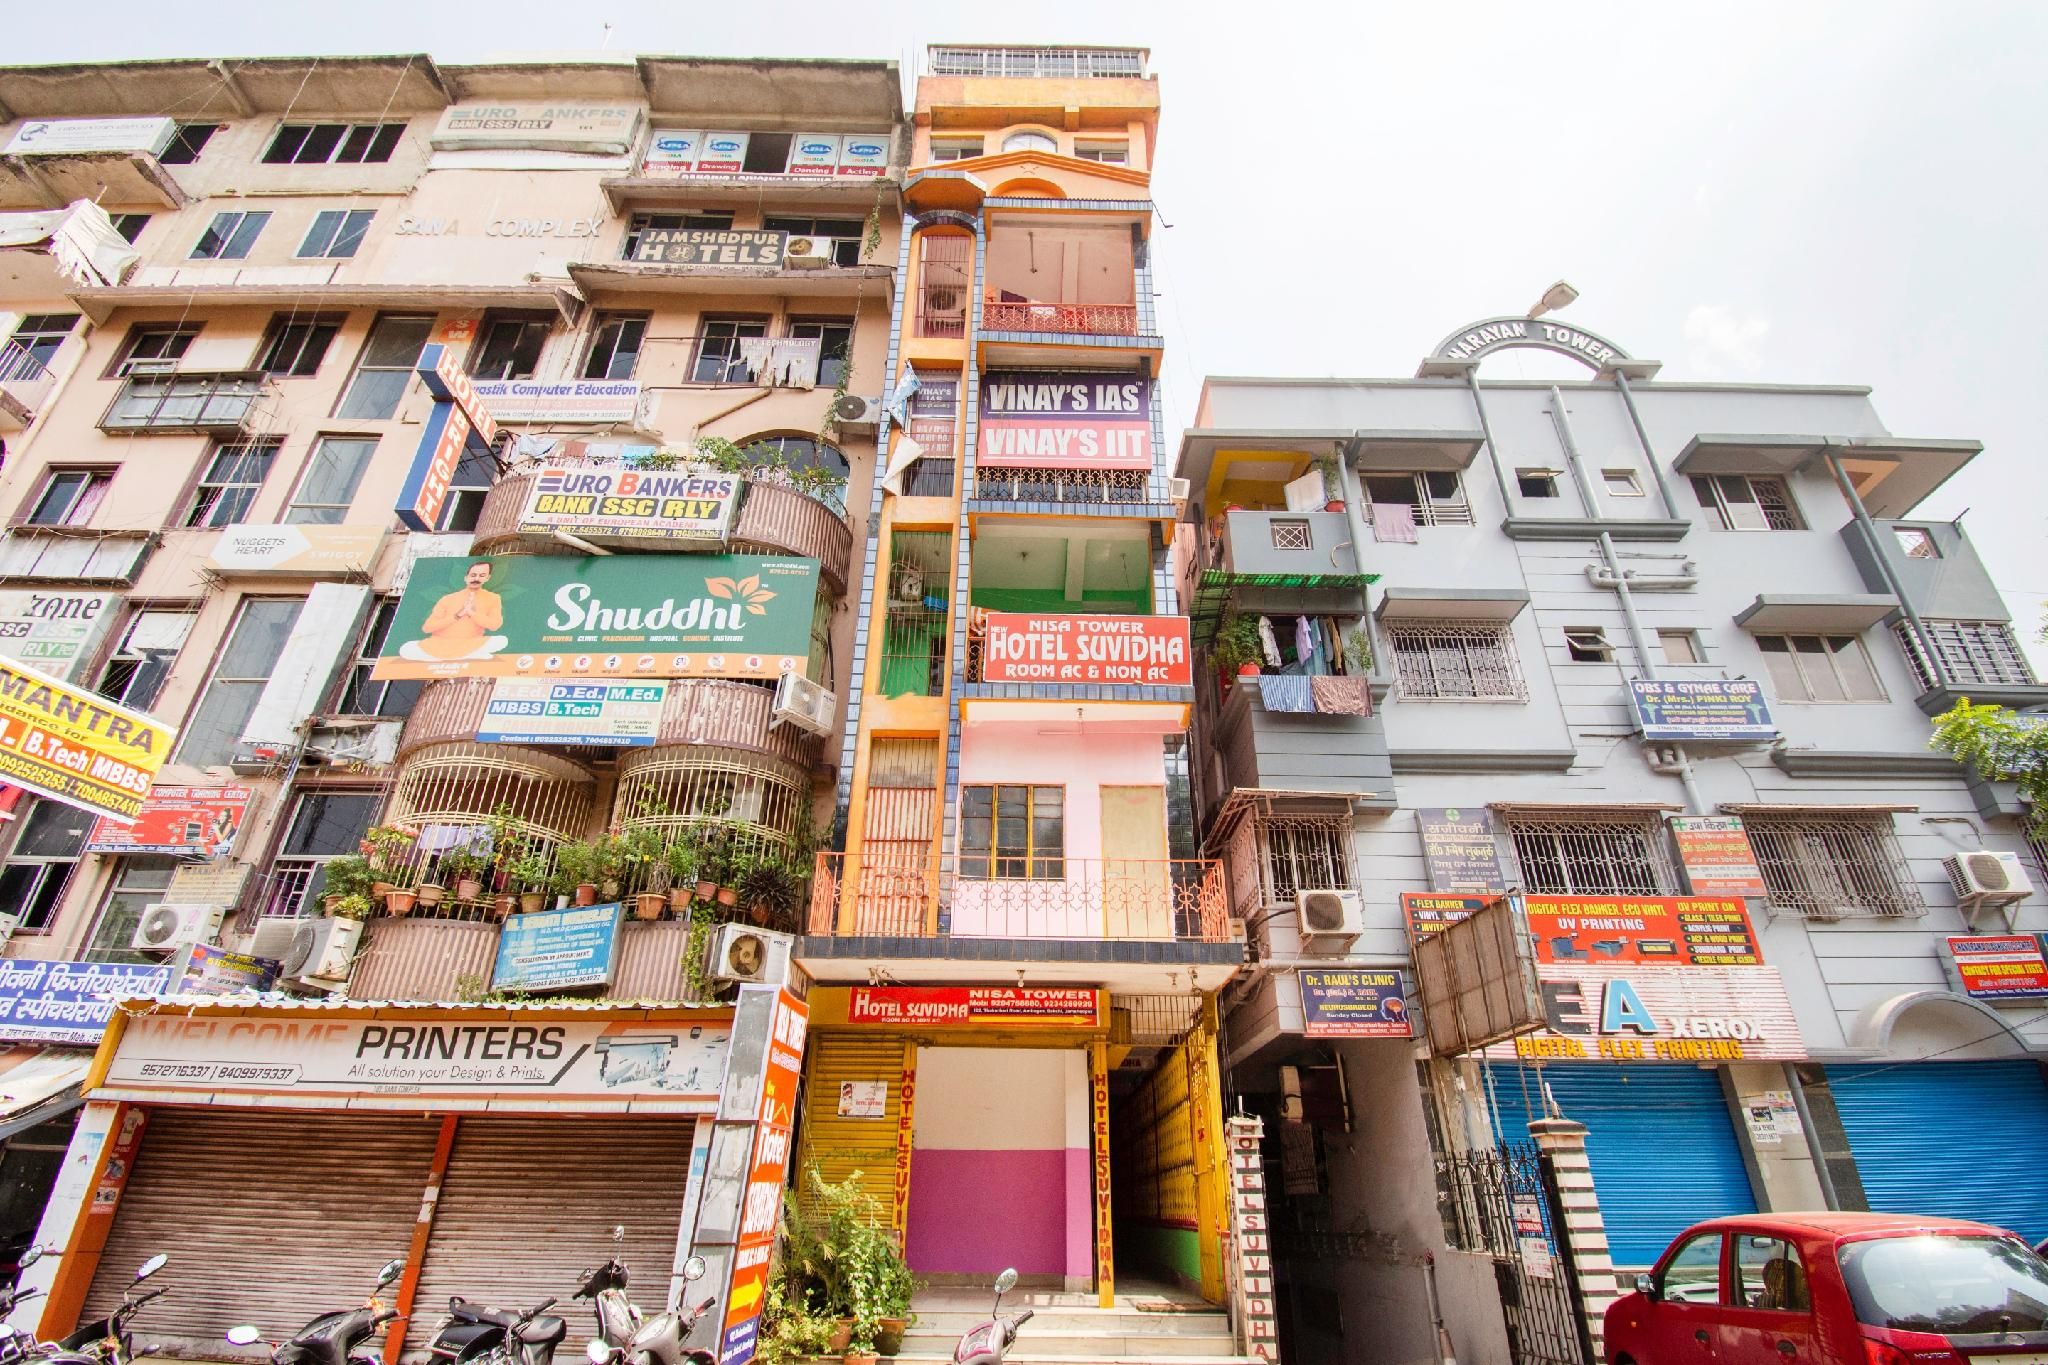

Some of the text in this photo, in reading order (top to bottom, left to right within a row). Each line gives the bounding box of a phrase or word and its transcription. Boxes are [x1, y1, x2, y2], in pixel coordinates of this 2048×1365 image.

[648, 163, 687, 171] Singing
[701, 163, 737, 171] Drawing
[846, 168, 879, 176] Acting
[486, 218, 604, 238] COMPLEX
[645, 231, 779, 244] JAMSHEDPUR
[1447, 322, 1614, 363] NARAYAN TOWER
[441, 350, 493, 438] HOTEL
[512, 384, 637, 396] Computer Education
[988, 384, 1140, 413] VINAY'S IAS
[985, 427, 1145, 457] VINAY'S IIT
[424, 408, 467, 513] BRIGHT
[537, 470, 732, 499] EURO BANKERS
[537, 496, 717, 518] BANK SSC RLY
[232, 537, 286, 546] NUGGETS
[234, 546, 274, 555] HEART
[547, 583, 746, 631] Shuddhi
[1028, 619, 1144, 634] NISA TOWER
[989, 626, 1184, 664] NEW HOTEL SUVIDHA
[1005, 663, 1169, 680] ROOM AC & NON AC
[552, 686, 603, 699] D.Ed.
[609, 688, 660, 701] M.Ed.
[1635, 683, 1758, 694] OBS & GYNAE CARE
[1664, 695, 1695, 704] (Mrs.)
[1729, 695, 1752, 703] ROY
[0, 669, 154, 753] MANTRA
[490, 701, 543, 714] MBBS
[547, 702, 600, 716] B.Tech
[63, 726, 89, 742] for
[499, 735, 529, 743] Contact
[26, 730, 89, 772] B.Tech
[90, 755, 151, 795] MBBS
[72, 780, 143, 817] 7004857410
[1416, 899, 1464, 909] FLEX BANNER
[1527, 903, 1667, 916] DIGITAL FLEX BANNER, ECO VINYL
[1677, 902, 1736, 911] UV PRINT ON
[1418, 911, 1440, 920] VINYL
[1557, 918, 1646, 931] UV PRINTING
[1712, 924, 1731, 932] PRINT
[1728, 935, 1747, 943] PRINT
[1727, 945, 1747, 954] PRINT
[1305, 974, 1395, 986] Dr. RAUL'S CLINIC
[969, 989, 1091, 999] NISA TOWER
[854, 993, 969, 1018] HOTEL SUVIDHA
[1667, 1016, 1765, 1039] XEROX
[141, 1019, 566, 1060] WELCOME PRINTERS
[1516, 1038, 1744, 1059] DIGITAL FLEX PRINTING
[140, 1064, 294, 1080] 9572716337 8409979337
[348, 1065, 365, 1076] All
[367, 1065, 415, 1078] solution
[419, 1069, 447, 1083] your
[450, 1065, 493, 1081] Design
[496, 1066, 505, 1078] &
